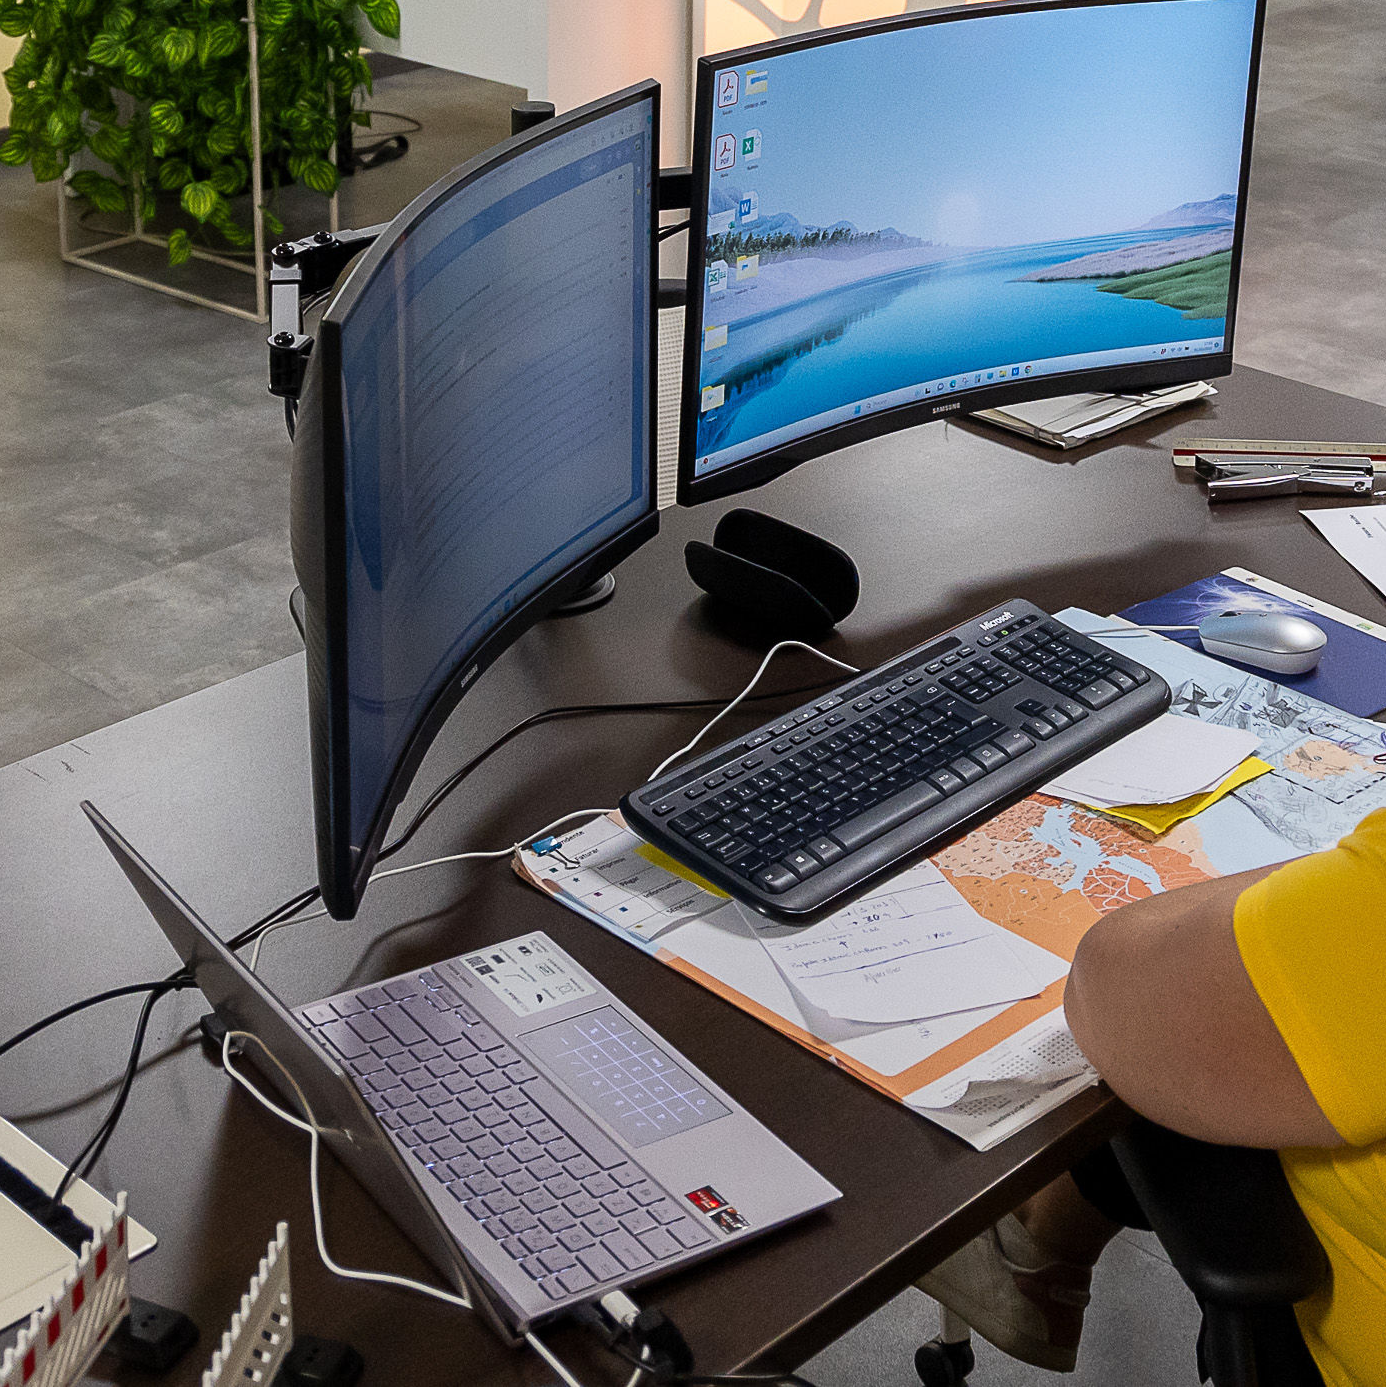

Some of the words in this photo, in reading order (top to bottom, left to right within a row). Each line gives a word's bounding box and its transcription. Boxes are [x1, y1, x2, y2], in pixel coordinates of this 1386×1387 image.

[932, 402, 961, 414] SAMSUNG
[979, 611, 1014, 631] Microsoft
[461, 664, 478, 688] SAMSUNG
[642, 878, 683, 899] Informativo
